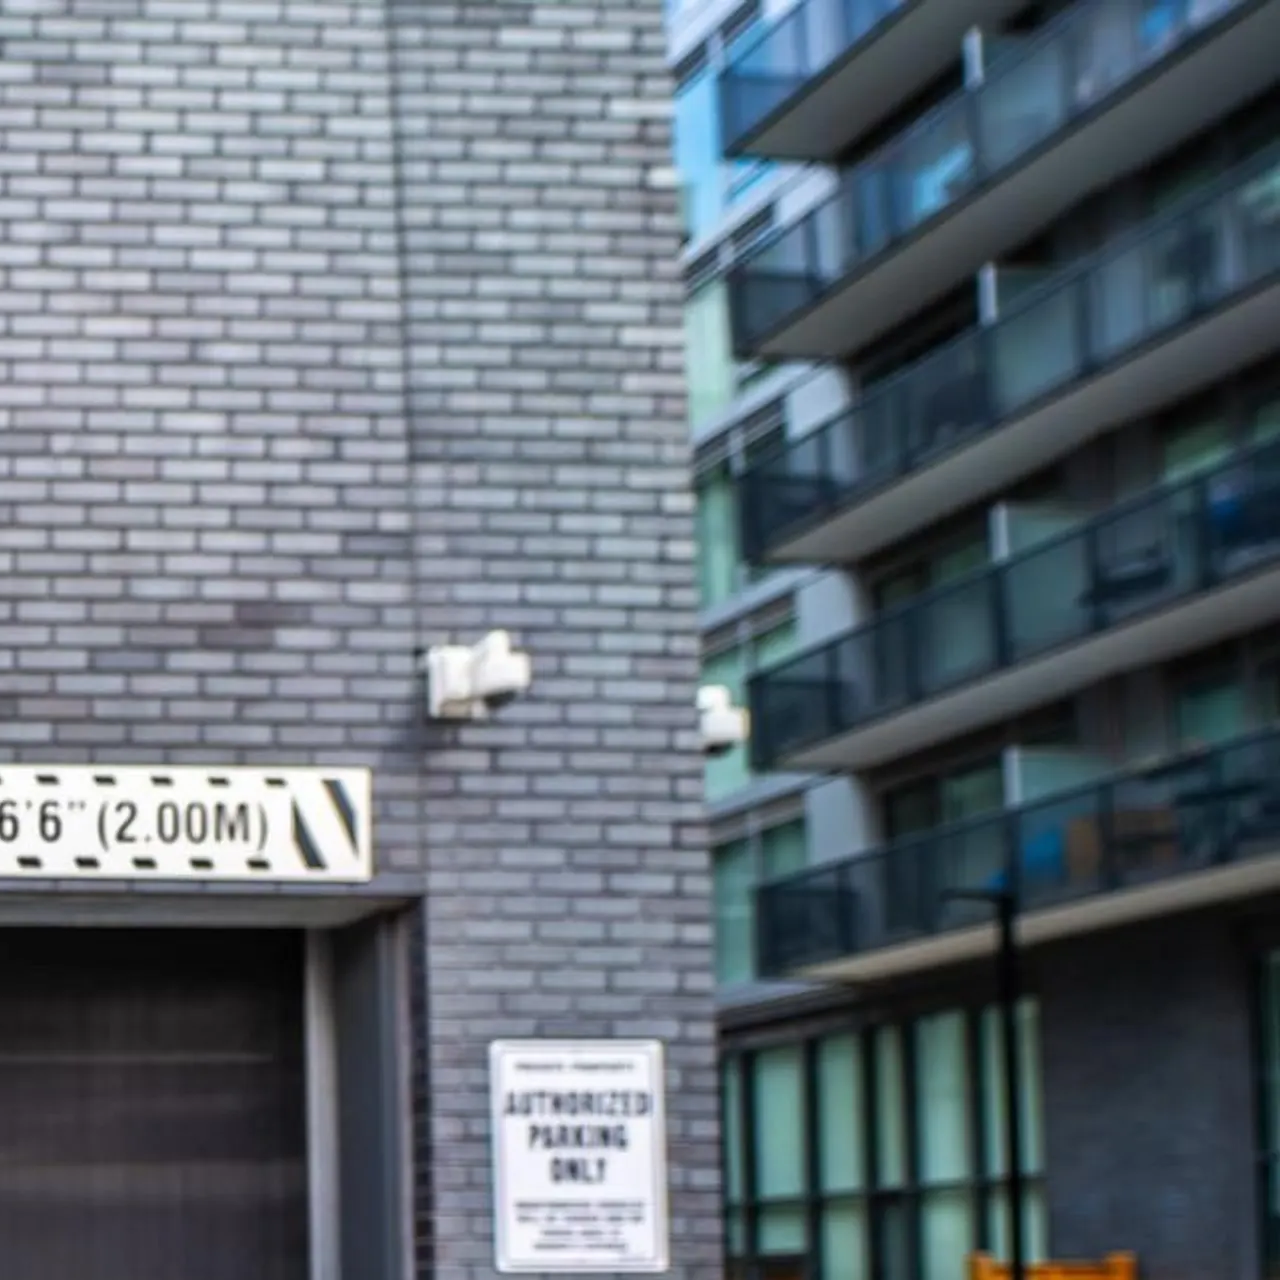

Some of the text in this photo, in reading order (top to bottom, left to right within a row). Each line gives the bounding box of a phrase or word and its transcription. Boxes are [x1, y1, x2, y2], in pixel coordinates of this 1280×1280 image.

[97, 800, 269, 852] (2.00M)
[505, 1090, 654, 1116] AUTHORIZED
[528, 1124, 630, 1150] PARKING
[549, 1157, 607, 1184] ONLY
